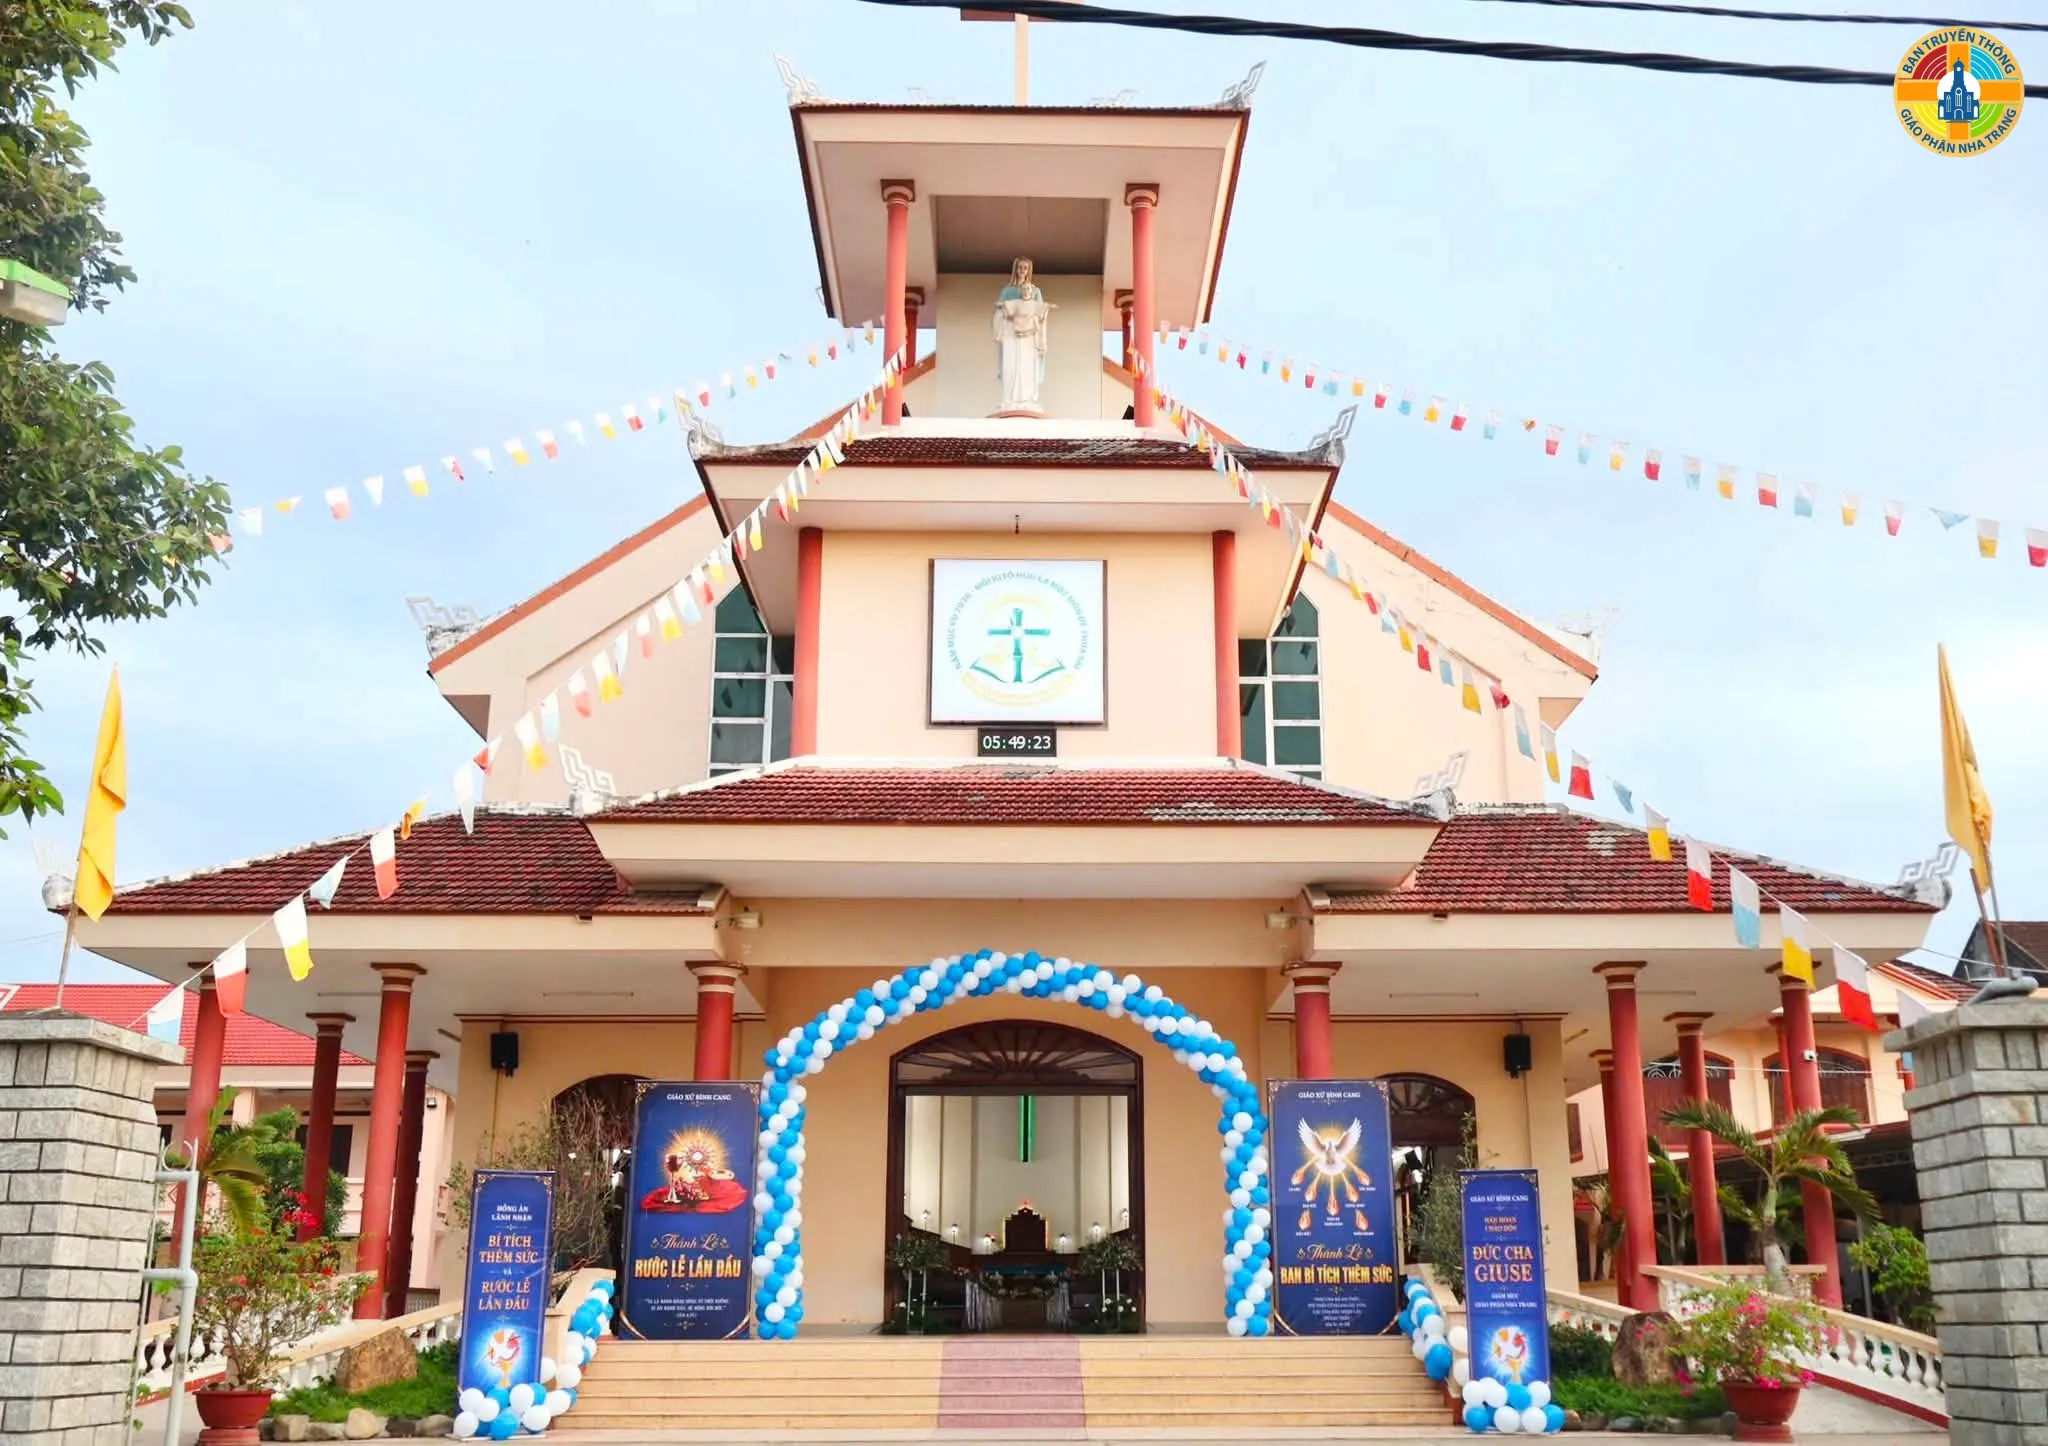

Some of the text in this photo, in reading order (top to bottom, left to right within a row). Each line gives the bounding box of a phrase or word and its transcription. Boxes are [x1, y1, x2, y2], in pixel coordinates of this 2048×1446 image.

[982, 735, 1052, 750] 05:49:23
[488, 1231, 532, 1248] BÍ TÍCH
[479, 1248, 539, 1264] THÊM SỨC
[1472, 1243, 1534, 1260] ĐỨC CHA
[634, 1255, 669, 1278] RƯỚC
[671, 1253, 687, 1278] LỄ
[1280, 1263, 1393, 1285] BAN BÍ TÍCH THÊM SỨC
[1474, 1263, 1533, 1283] GIUSE
[481, 1276, 531, 1294] RƯỚC LỄ
